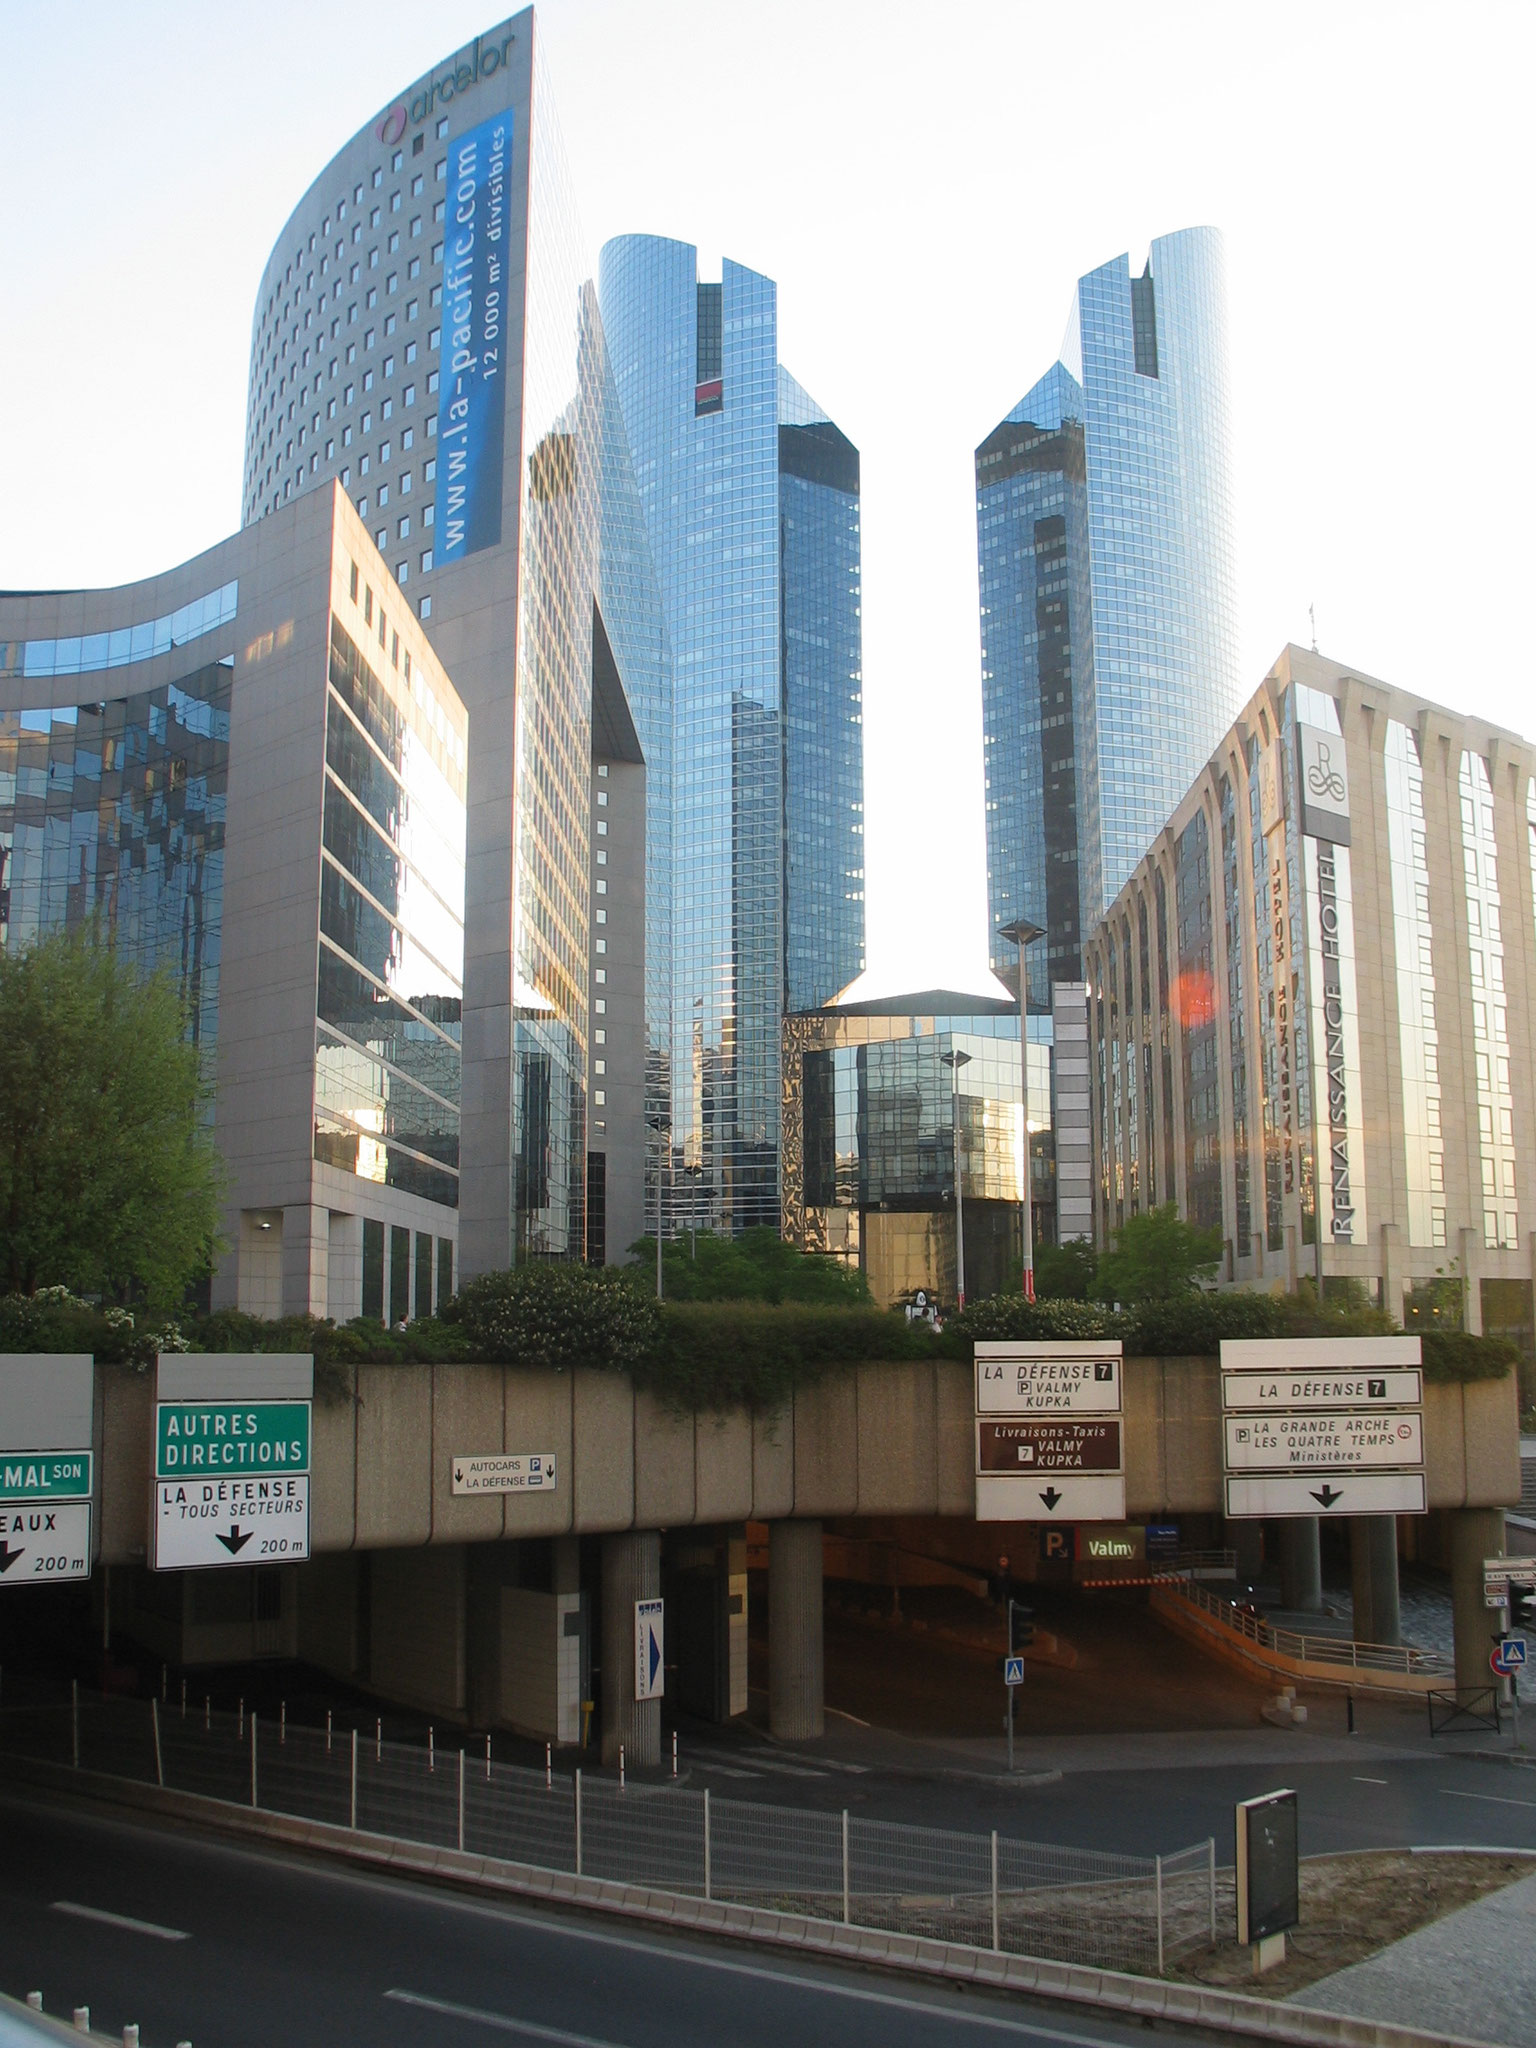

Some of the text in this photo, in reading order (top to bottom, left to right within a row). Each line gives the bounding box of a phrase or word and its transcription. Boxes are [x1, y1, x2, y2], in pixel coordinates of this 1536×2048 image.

[409, 36, 515, 124] arcelor
[487, 126, 505, 242] divisibles
[484, 290, 500, 341] 000
[442, 141, 478, 551] www.la-pacific.com
[482, 347, 498, 381] 12
[1319, 854, 1355, 1236] RENAISSANCE HOTEL
[984, 1363, 1109, 1380] LA DÉFENSE 7
[1036, 1382, 1081, 1393] VALMY
[1259, 1381, 1382, 1398] LA DÉFENSE 7
[1026, 1396, 1071, 1407] KUPKA
[167, 1414, 258, 1437] AUTRES
[1254, 1422, 1270, 1433] LA
[1280, 1421, 1336, 1433] GRANDE
[1345, 1419, 1390, 1432] ARCHE
[1038, 1440, 1084, 1452] VALMY
[1254, 1434, 1395, 1448] LES QUATRE TEMPS
[166, 1441, 302, 1466] DIRECTIONS
[1036, 1455, 1083, 1466] KUPKA
[1289, 1450, 1362, 1462] Ministères
[470, 1461, 521, 1472] AUTOCARS
[466, 1476, 525, 1488] LA DÉFENSE
[164, 1481, 296, 1504] LA DÉFENSE
[180, 1503, 220, 1519] TOUS
[229, 1499, 304, 1517] SECTEURS
[260, 1538, 303, 1554] 200 m
[1046, 1532, 1064, 1557] P
[1088, 1540, 1137, 1560] Valmy
[34, 1556, 84, 1572] 200 m
